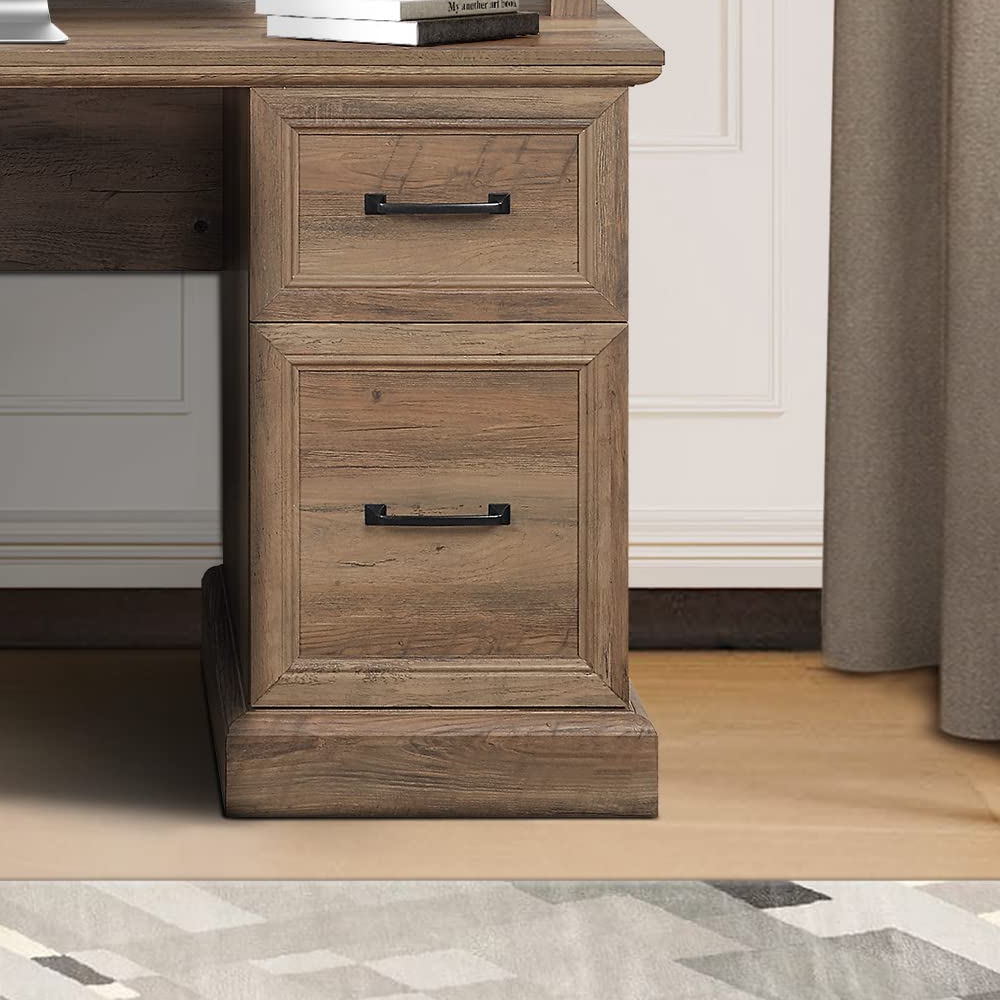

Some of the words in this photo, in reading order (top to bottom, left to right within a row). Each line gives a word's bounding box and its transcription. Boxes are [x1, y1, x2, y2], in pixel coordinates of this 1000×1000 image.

[447, 1, 460, 14] My
[461, 0, 488, 11] another
[489, 0, 500, 9] art
